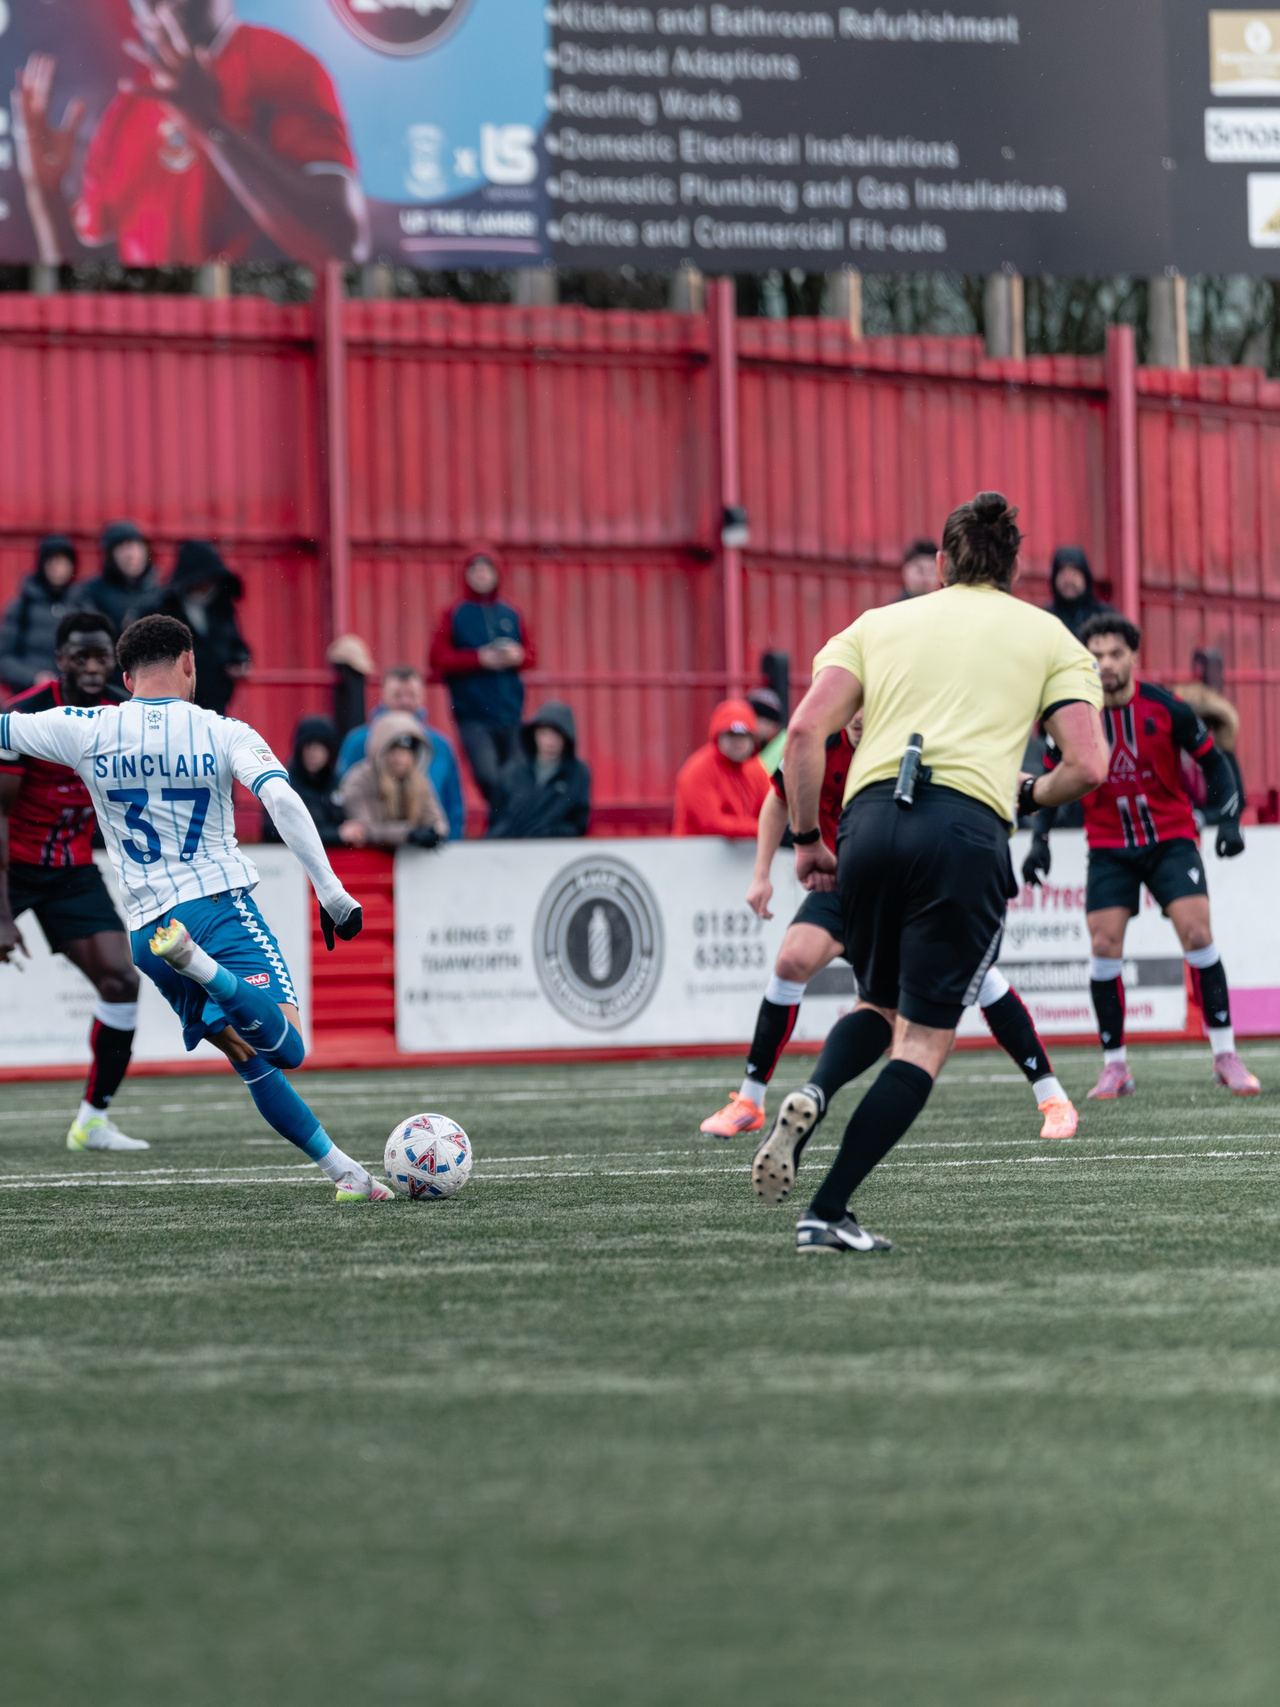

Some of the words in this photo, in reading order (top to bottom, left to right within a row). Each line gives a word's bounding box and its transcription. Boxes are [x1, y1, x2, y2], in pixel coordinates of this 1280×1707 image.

[558, 1, 653, 33] Kitchen
[656, 4, 707, 36] and
[710, 4, 834, 38] Bathroom
[839, 6, 1019, 44] Refurbishment
[558, 41, 669, 77] Disabled
[672, 44, 801, 85] Adaptions
[558, 84, 658, 126] Roofing
[659, 87, 742, 122] Works
[559, 126, 677, 163] Domestic
[679, 125, 801, 165] Electrical
[805, 132, 959, 169] Installations
[559, 169, 677, 205] Domestic
[680, 172, 799, 214] Plumbing
[803, 175, 852, 209] and
[857, 175, 910, 210] Gas
[915, 177, 1067, 213] Installations
[559, 212, 639, 247] Office
[641, 214, 691, 248] and
[694, 214, 844, 250] Commercial
[849, 217, 948, 253] Fit-outs
[95, 753, 216, 779] SINCLAIR
[106, 787, 211, 865] 37
